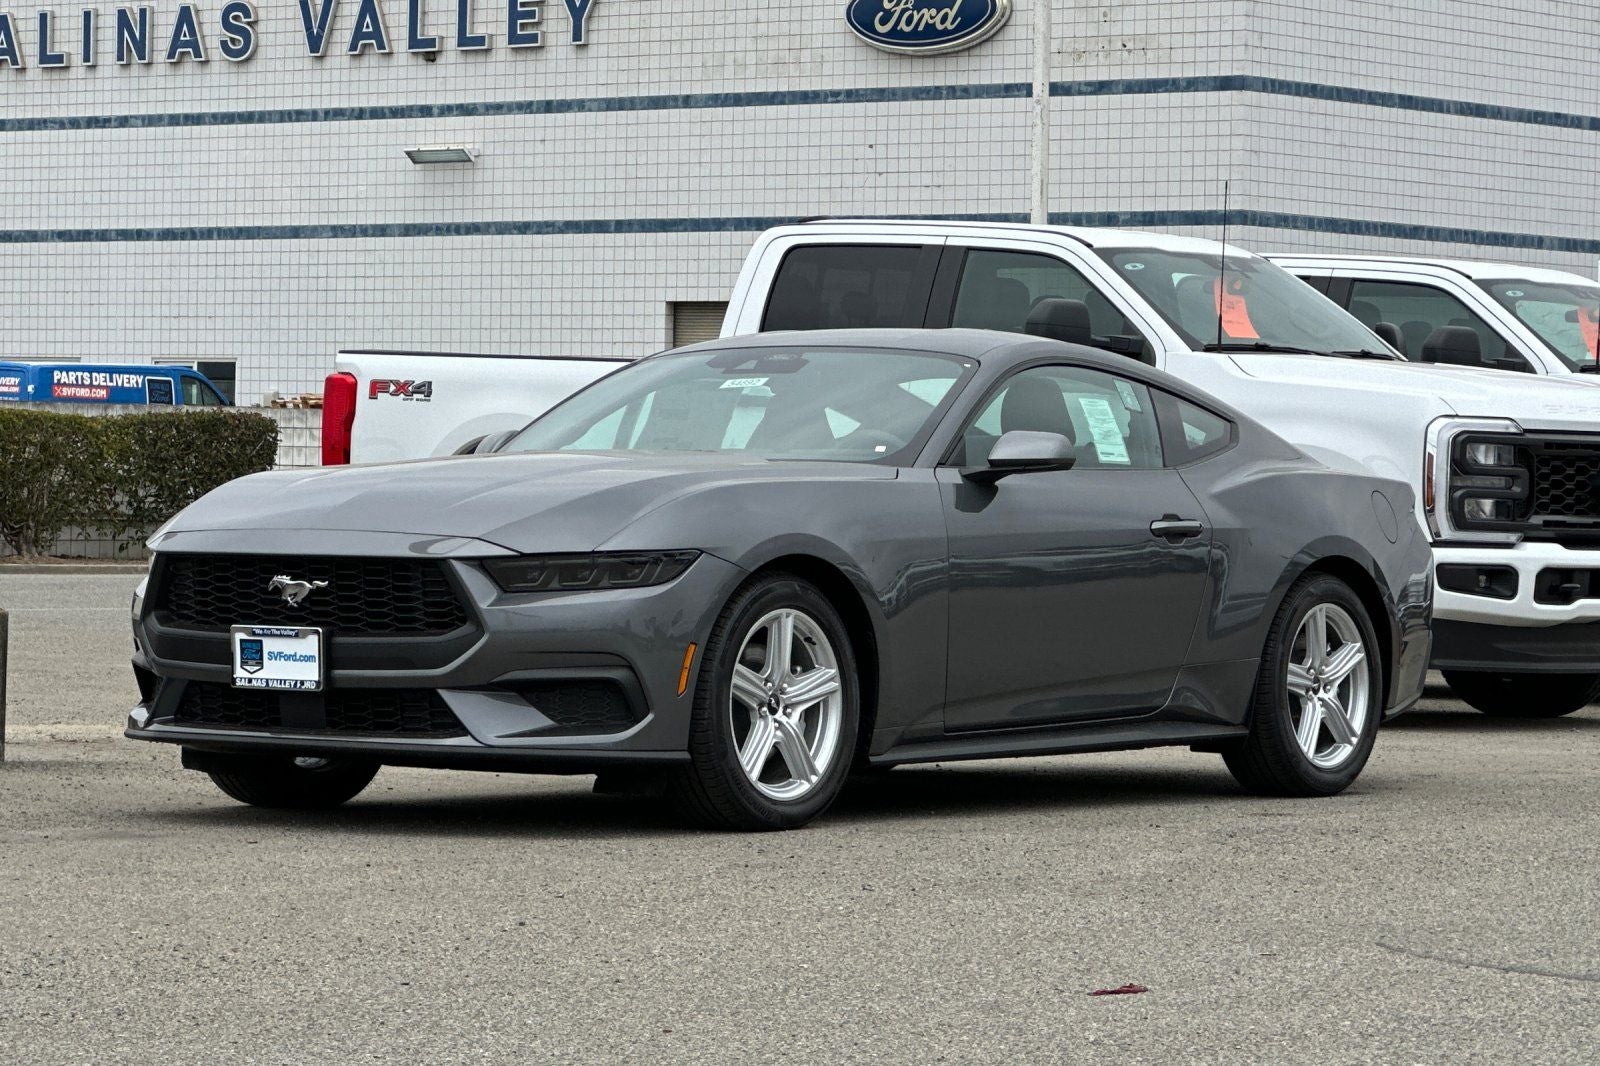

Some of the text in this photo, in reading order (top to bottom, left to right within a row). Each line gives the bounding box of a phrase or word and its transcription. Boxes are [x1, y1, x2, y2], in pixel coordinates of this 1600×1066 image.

[874, 0, 961, 33] Ford
[0, 0, 598, 69] ALINAS VALLEY
[53, 370, 91, 385] PARTS
[92, 372, 144, 388] DELIVERY
[62, 387, 107, 398] SVFORD.COM
[369, 379, 432, 399] FX4
[267, 650, 317, 663] SVFord.com
[235, 678, 267, 687] SALNAS
[268, 679, 296, 688] VALLEY
